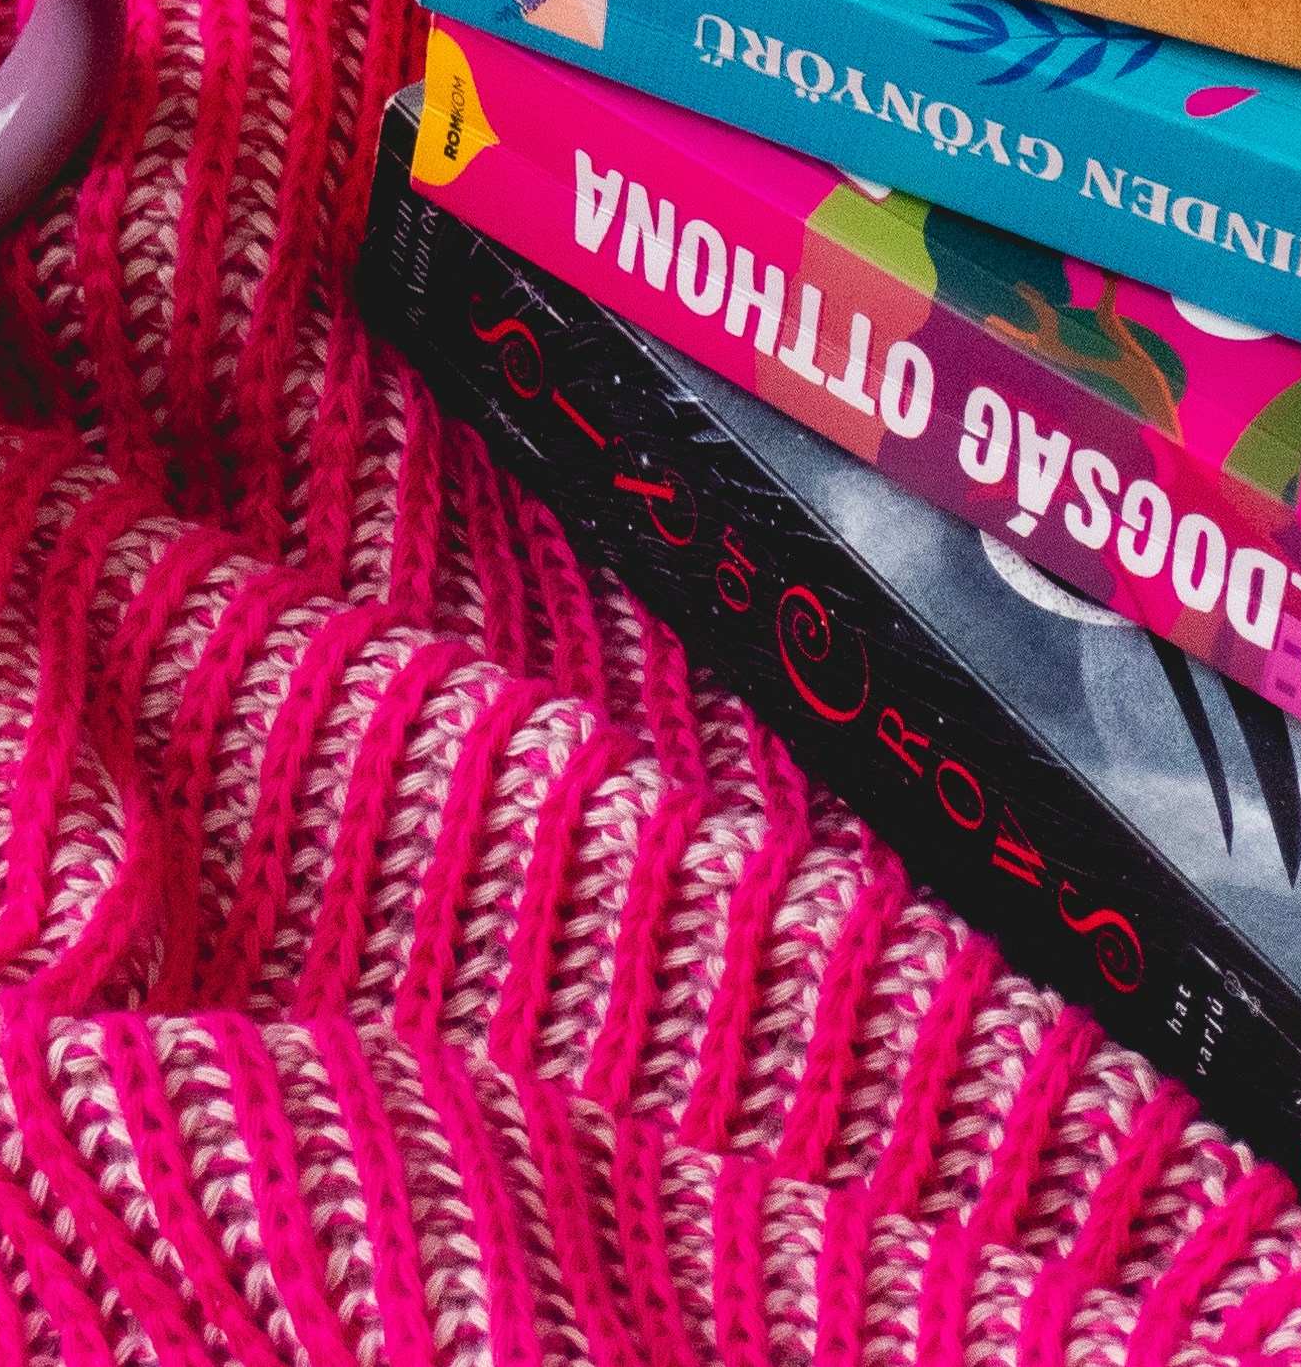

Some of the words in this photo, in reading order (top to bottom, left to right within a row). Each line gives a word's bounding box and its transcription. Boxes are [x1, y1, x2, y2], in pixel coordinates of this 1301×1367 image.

[443, 75, 469, 162] ROMKOM
[694, 13, 1065, 183] GYÖNYÖRŰ
[573, 148, 936, 440] OTTHONA
[469, 292, 698, 546] SIX
[775, 583, 1145, 994] CROWS
[1166, 982, 1193, 1036] hat
[1195, 994, 1228, 1078] varjú
